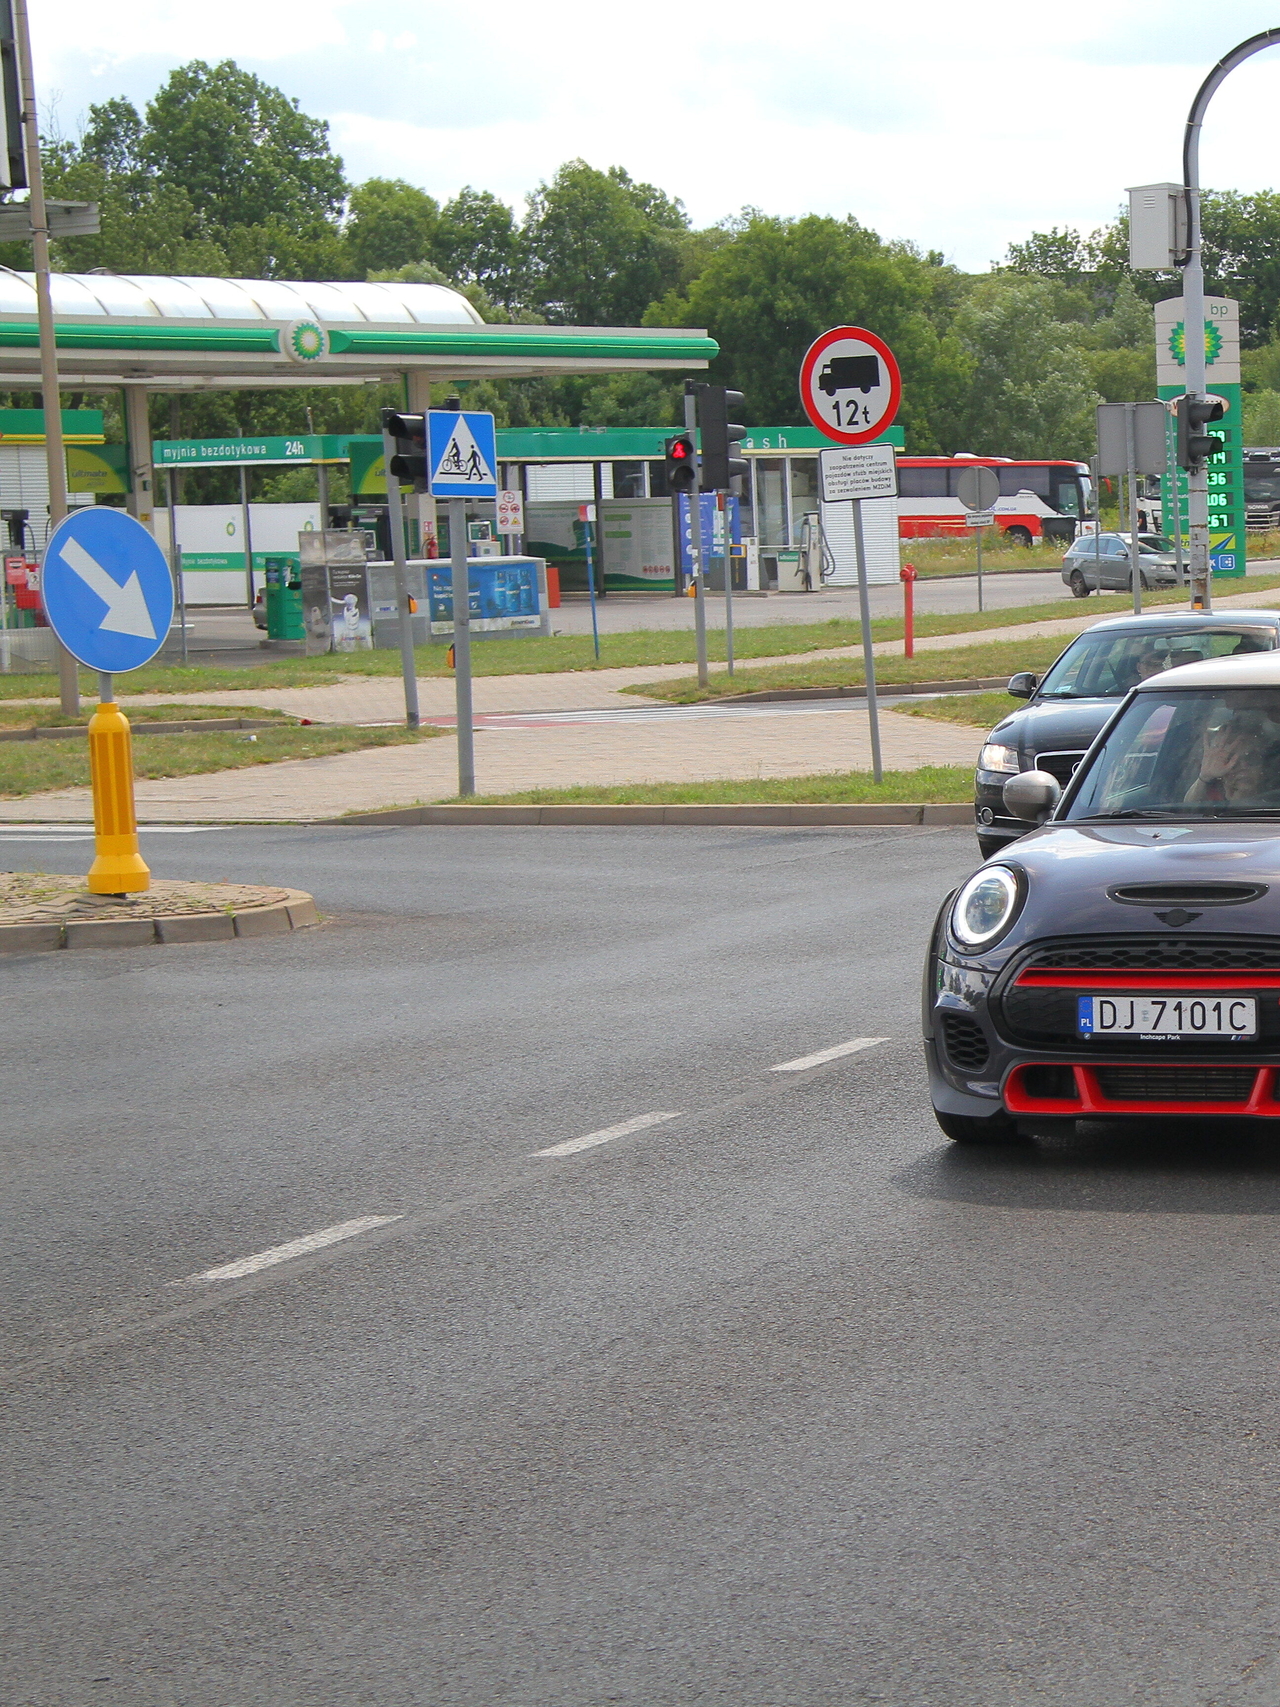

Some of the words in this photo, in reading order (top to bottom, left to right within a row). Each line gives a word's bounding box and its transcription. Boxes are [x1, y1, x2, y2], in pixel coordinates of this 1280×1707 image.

[1210, 304, 1228, 318] bp
[746, 433, 787, 449] ash
[163, 447, 197, 460] myjnia
[201, 443, 267, 458] bezdotykowa
[285, 441, 305, 456] 24h
[1080, 1018, 1092, 1027] PL
[1100, 1000, 1134, 1030] DJ
[1151, 1001, 1247, 1031] 7101C
